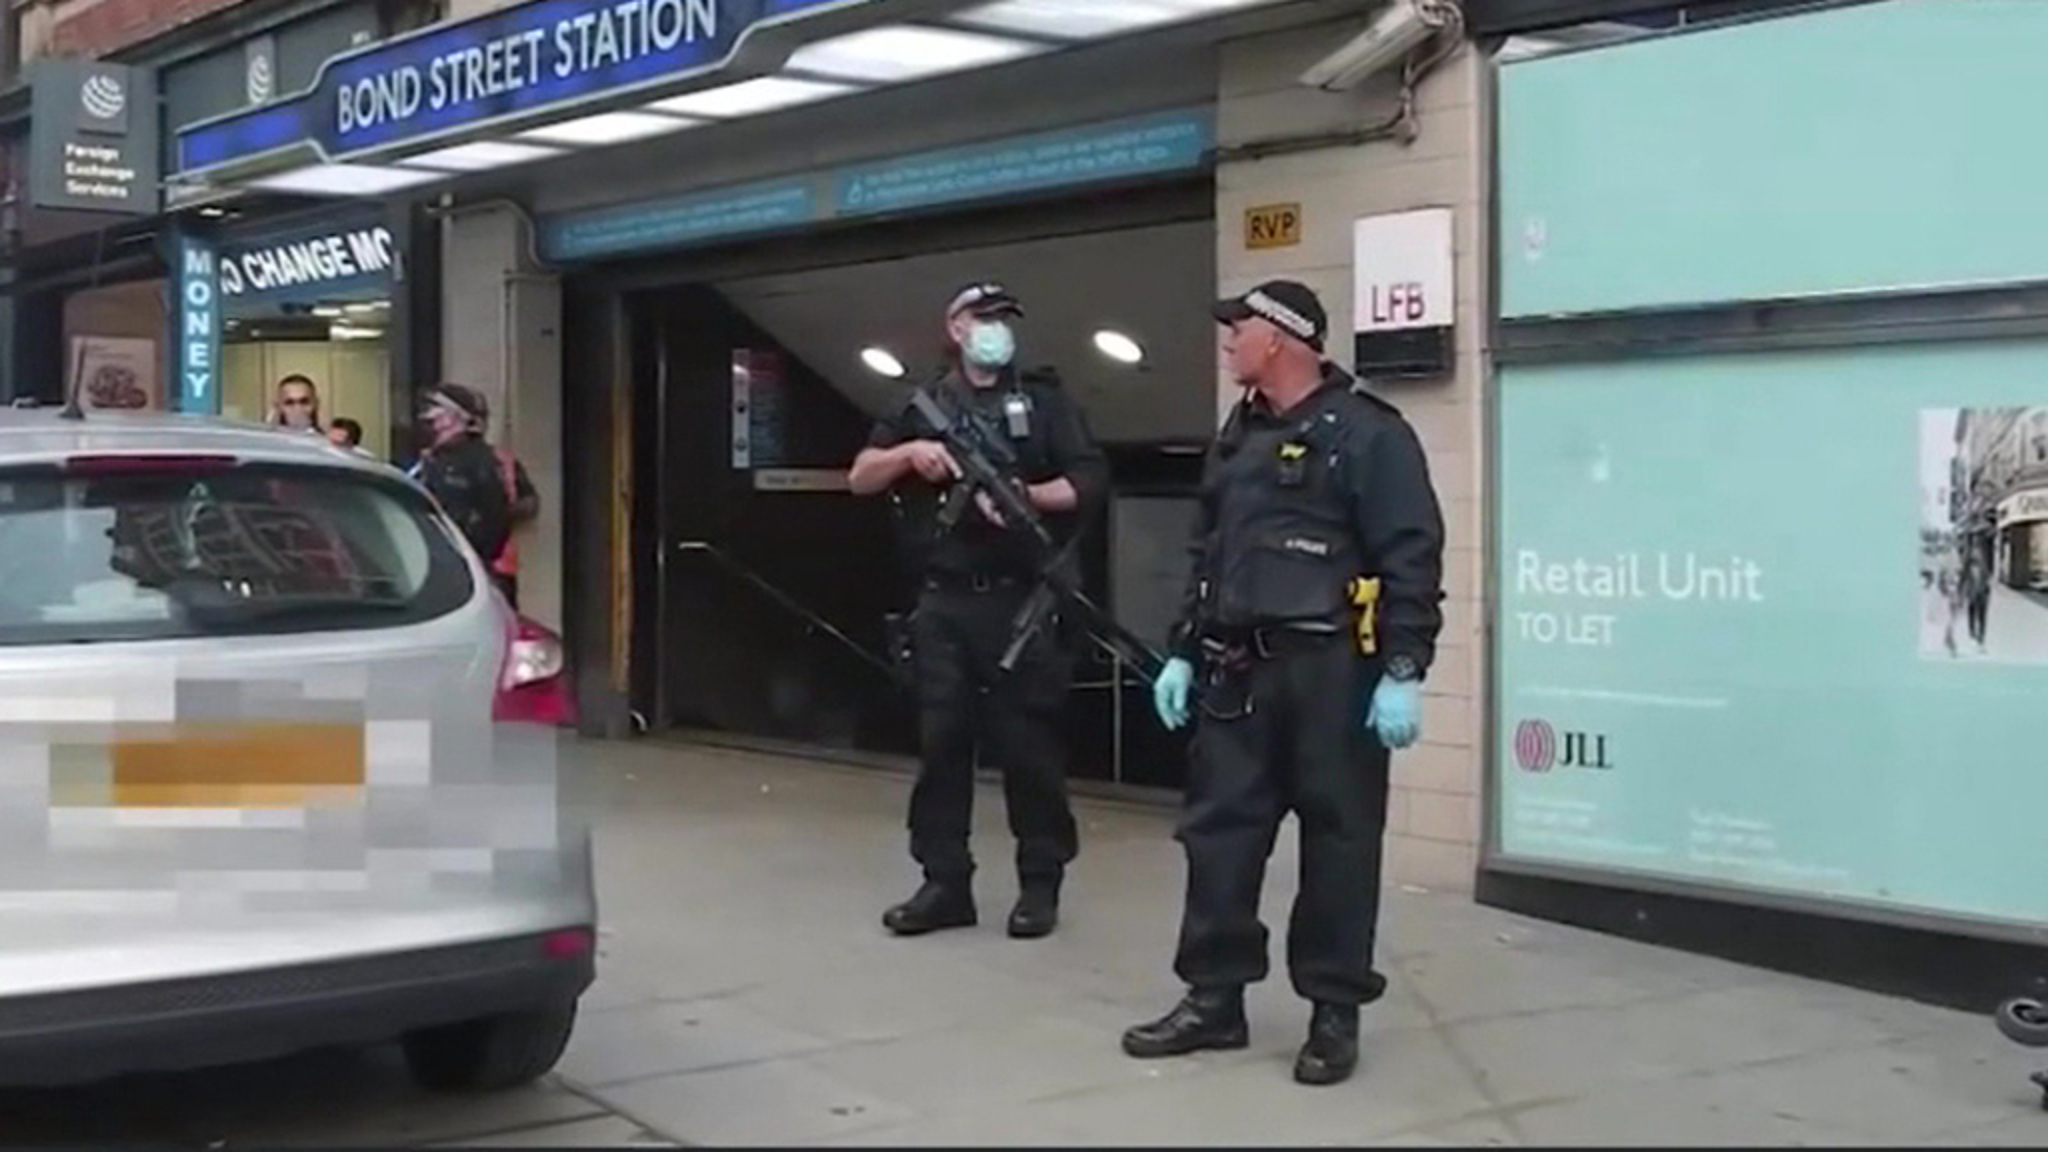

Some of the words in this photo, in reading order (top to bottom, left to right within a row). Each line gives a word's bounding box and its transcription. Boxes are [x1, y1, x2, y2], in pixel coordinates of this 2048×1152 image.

[337, 64, 422, 135] BOND
[429, 28, 545, 111] STREET
[553, 0, 716, 79] STATION
[64, 160, 136, 182] Exchange
[65, 178, 129, 198] Services
[1250, 211, 1296, 241] RVP
[241, 235, 358, 290] CHANGE
[1370, 281, 1426, 323] LFB
[185, 249, 213, 399] MONEY
[1516, 549, 1646, 598] Retail
[1658, 551, 1765, 602] Unit
[1516, 611, 1559, 644] TO
[1565, 614, 1618, 646] LET
[1557, 730, 1614, 770] JLL
